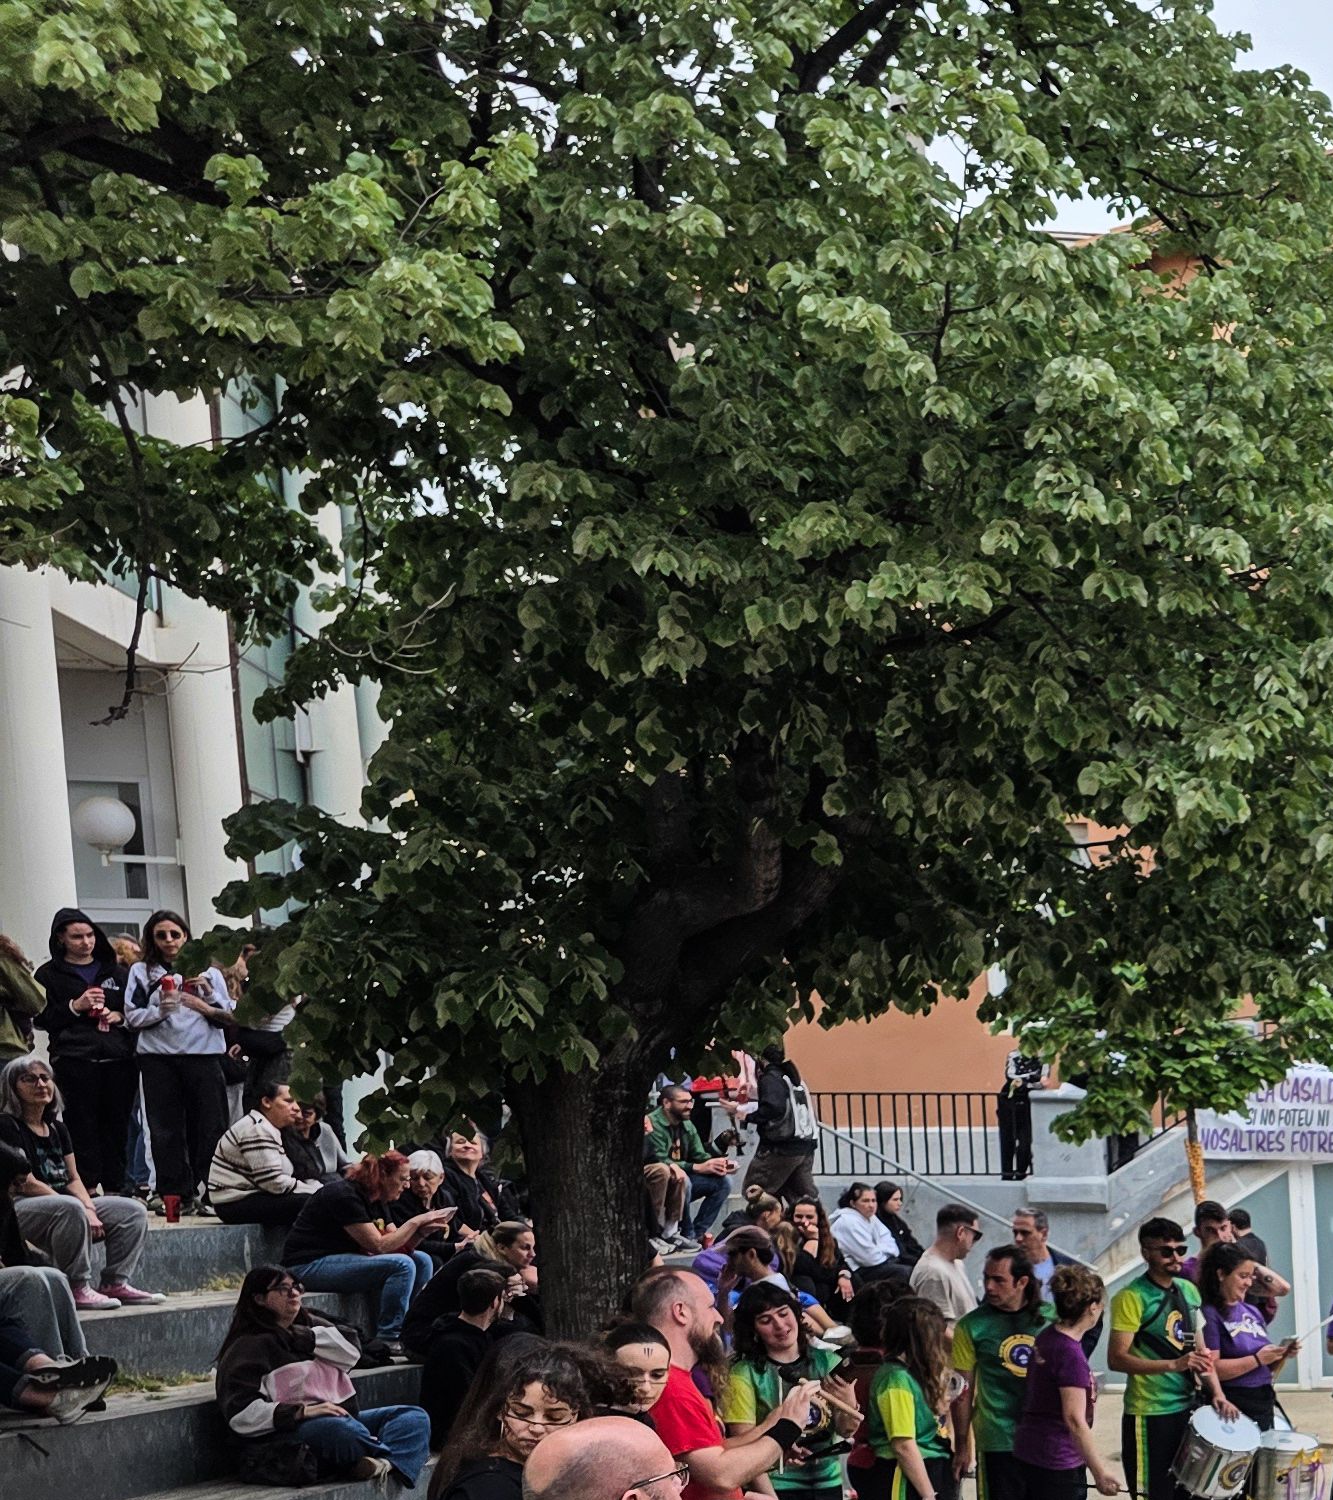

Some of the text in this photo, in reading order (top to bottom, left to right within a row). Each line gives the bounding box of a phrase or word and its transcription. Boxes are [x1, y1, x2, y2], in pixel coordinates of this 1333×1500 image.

[1280, 1076, 1321, 1103] CASA
[1260, 1108, 1275, 1126] NO
[1278, 1108, 1314, 1127] FOTEU
[1317, 1109, 1330, 1126] NI
[1201, 1127, 1286, 1152] NOSALTRES
